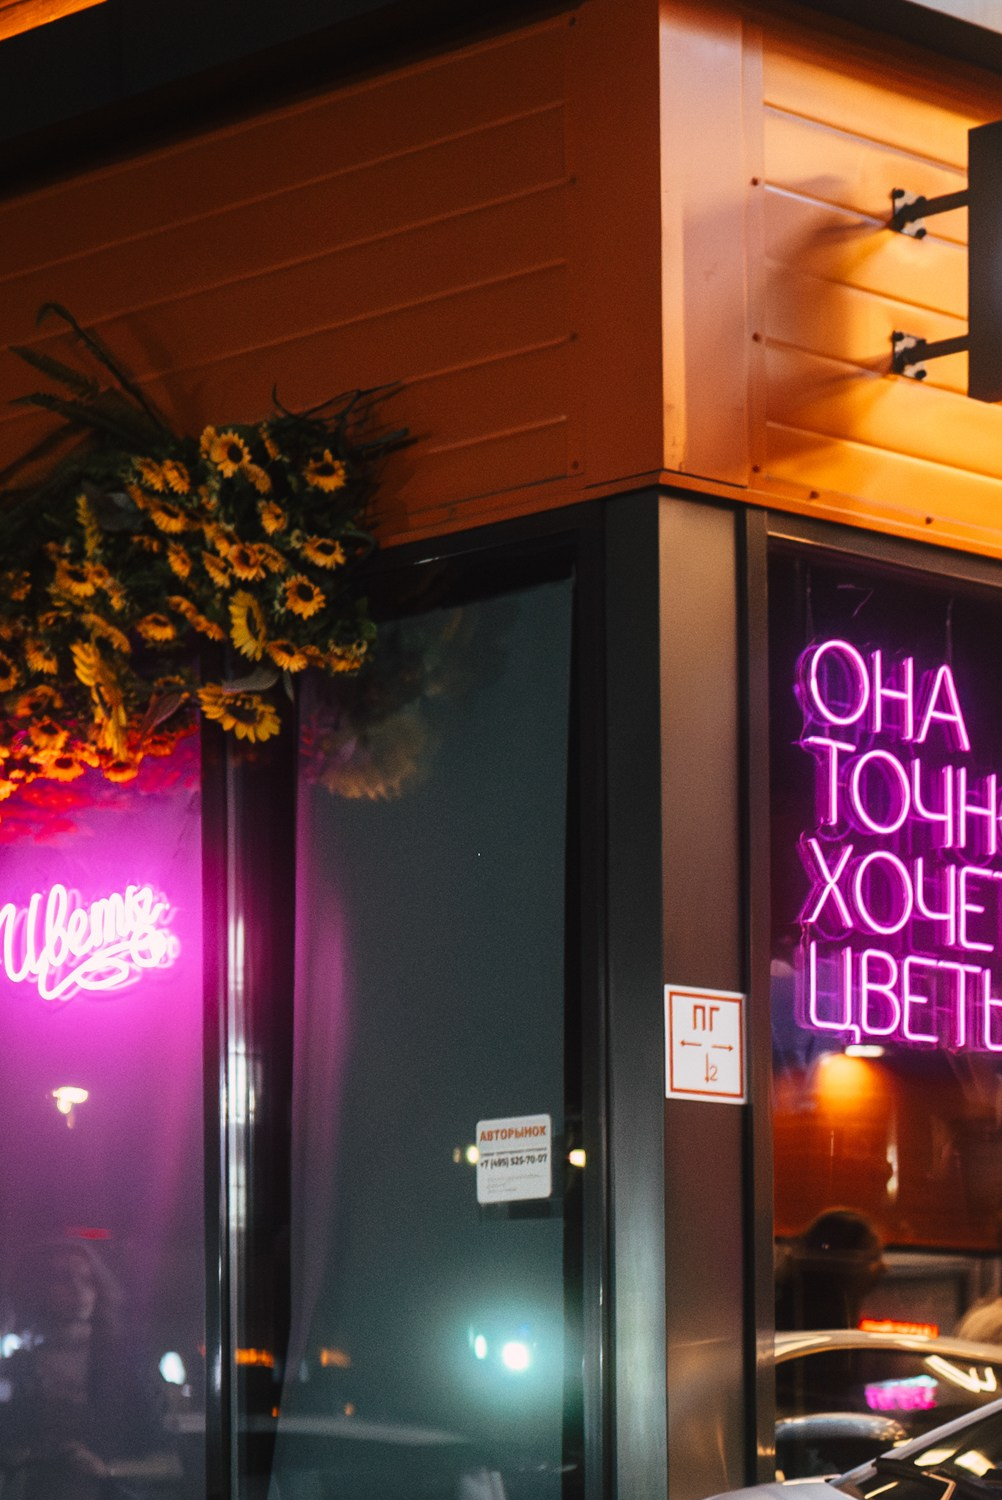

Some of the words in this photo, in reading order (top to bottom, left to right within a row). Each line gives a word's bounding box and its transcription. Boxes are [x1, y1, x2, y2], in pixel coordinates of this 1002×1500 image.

[810, 639, 971, 753] ОНА
[692, 1004, 720, 1032] ПГ
[709, 1065, 718, 1082] 2
[480, 1125, 546, 1141] АВТОРЫНОК
